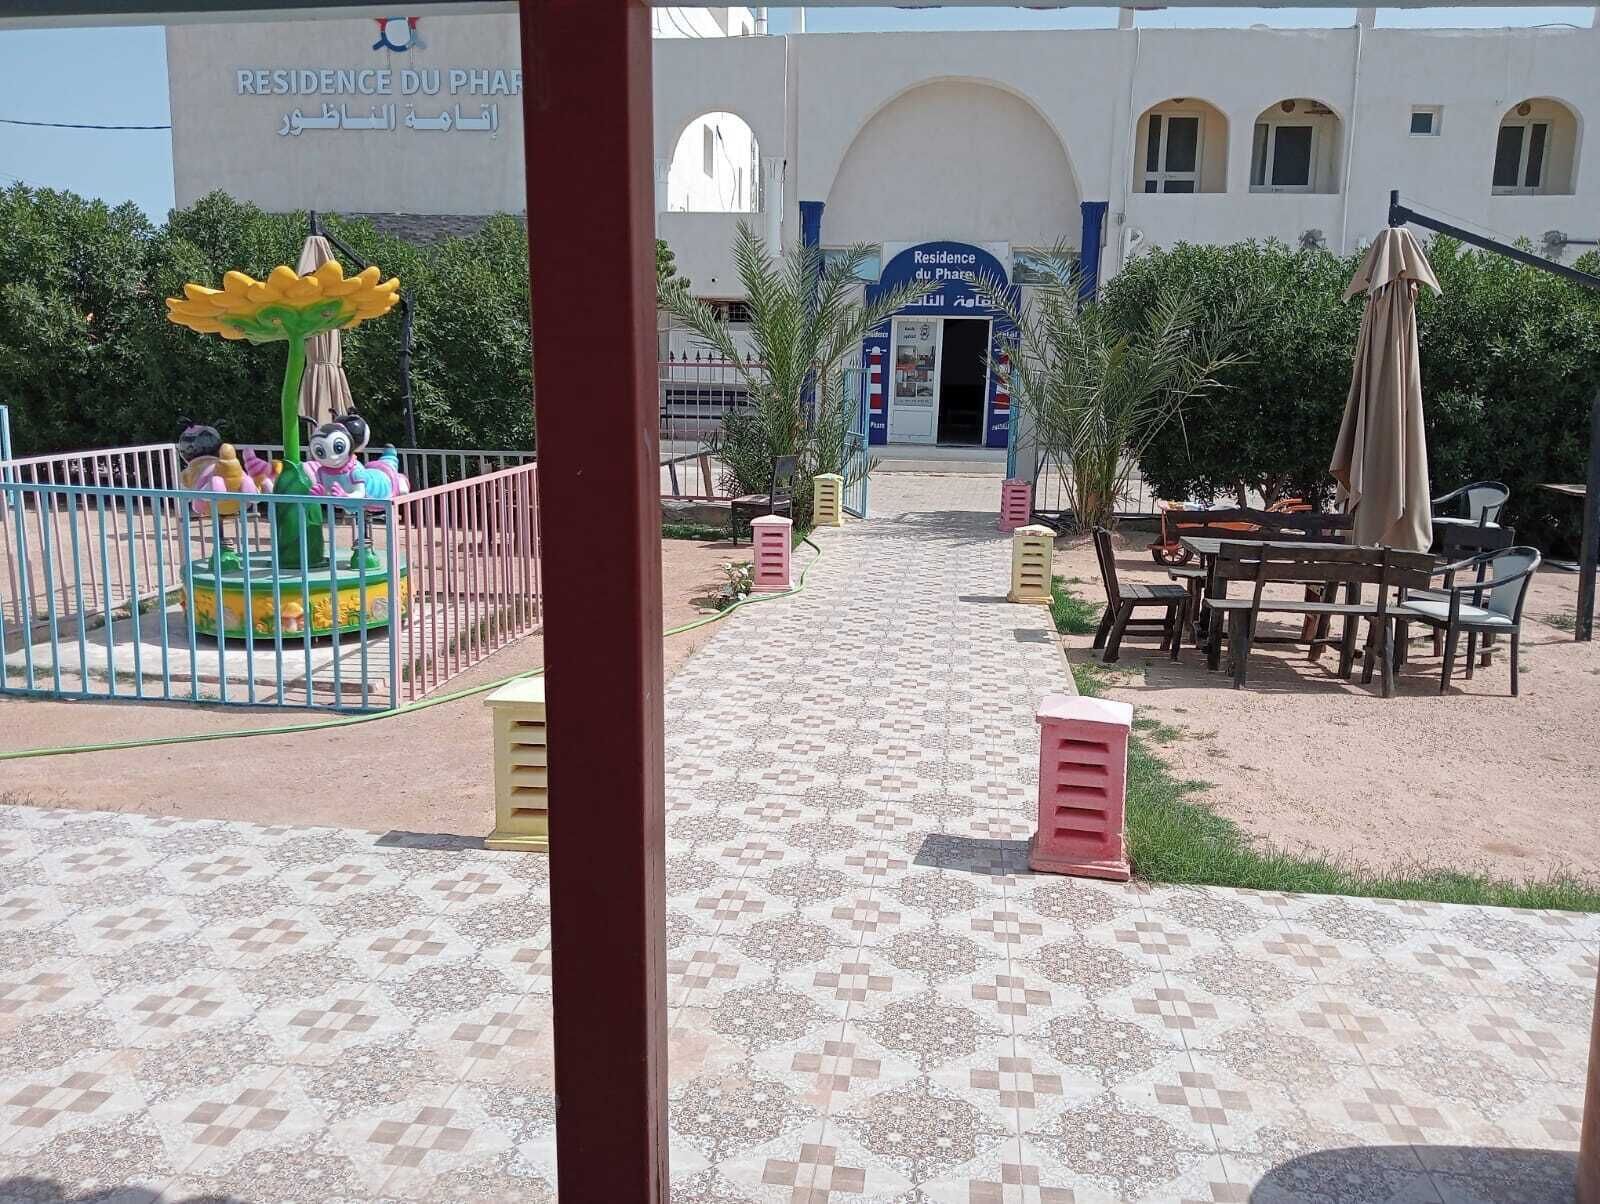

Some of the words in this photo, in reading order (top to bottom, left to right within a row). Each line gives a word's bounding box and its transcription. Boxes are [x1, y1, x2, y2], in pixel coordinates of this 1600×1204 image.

[237, 69, 393, 95] RESIDENCE
[400, 69, 441, 95] DU
[449, 69, 522, 96] PHAR
[277, 103, 397, 136] الناظور
[405, 103, 498, 139] إقامة
[914, 250, 976, 264] Residence
[915, 267, 931, 280] du
[935, 267, 973, 280] Phare
